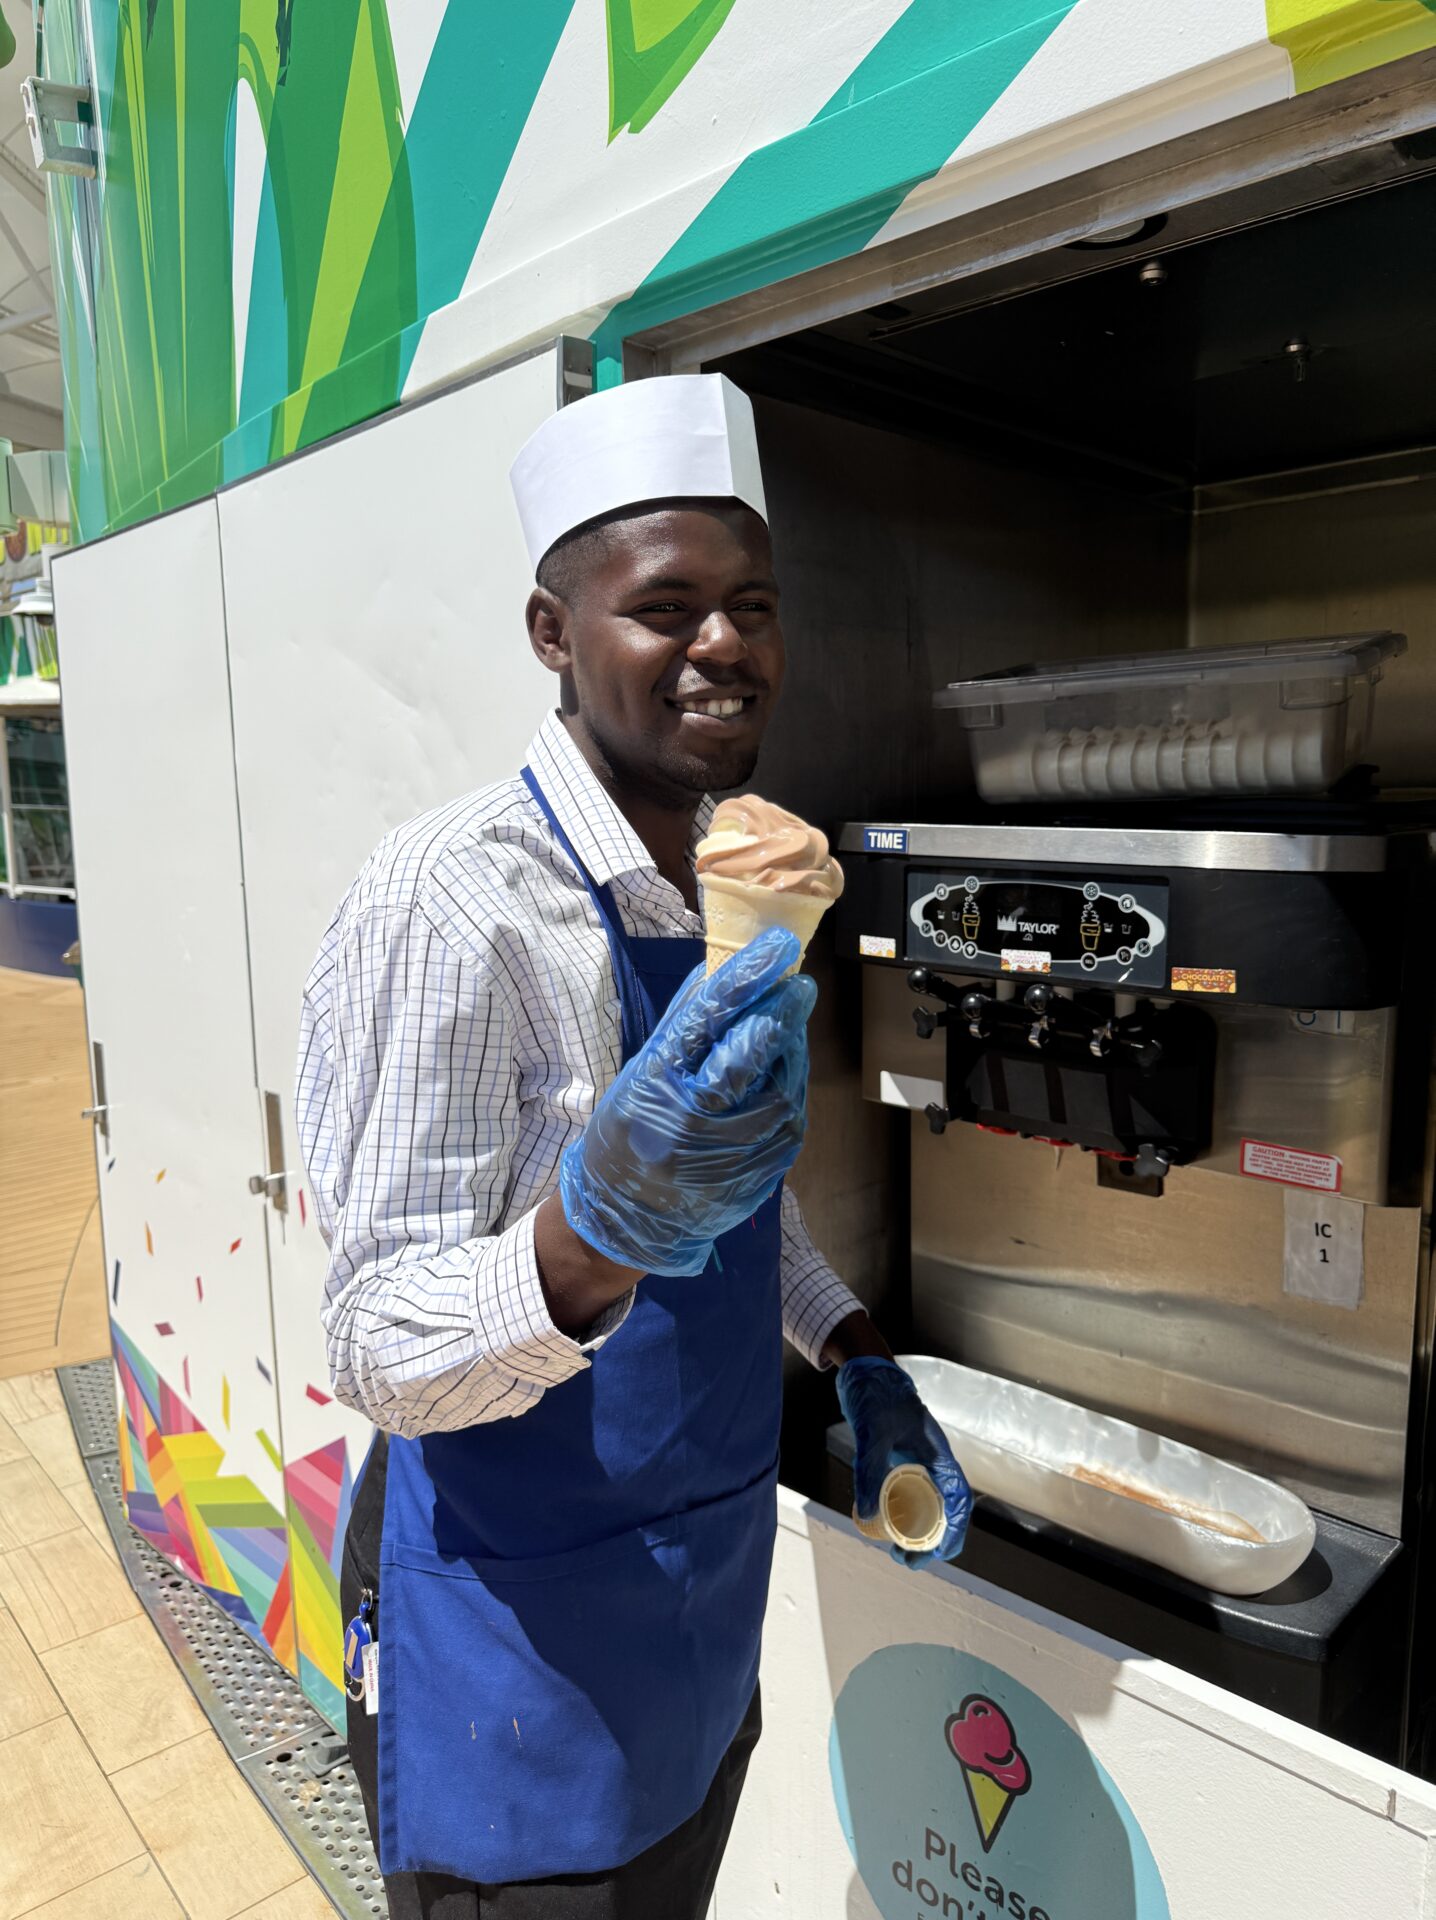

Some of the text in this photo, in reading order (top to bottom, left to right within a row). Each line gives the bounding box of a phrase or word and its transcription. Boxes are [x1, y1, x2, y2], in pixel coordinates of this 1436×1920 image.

[868, 832, 903, 849] TIME
[1018, 921, 1057, 935] TAYLOR
[1181, 973, 1225, 981] CHOCOLATE
[1315, 1222, 1332, 1238] IC
[1320, 1248, 1329, 1263] 1
